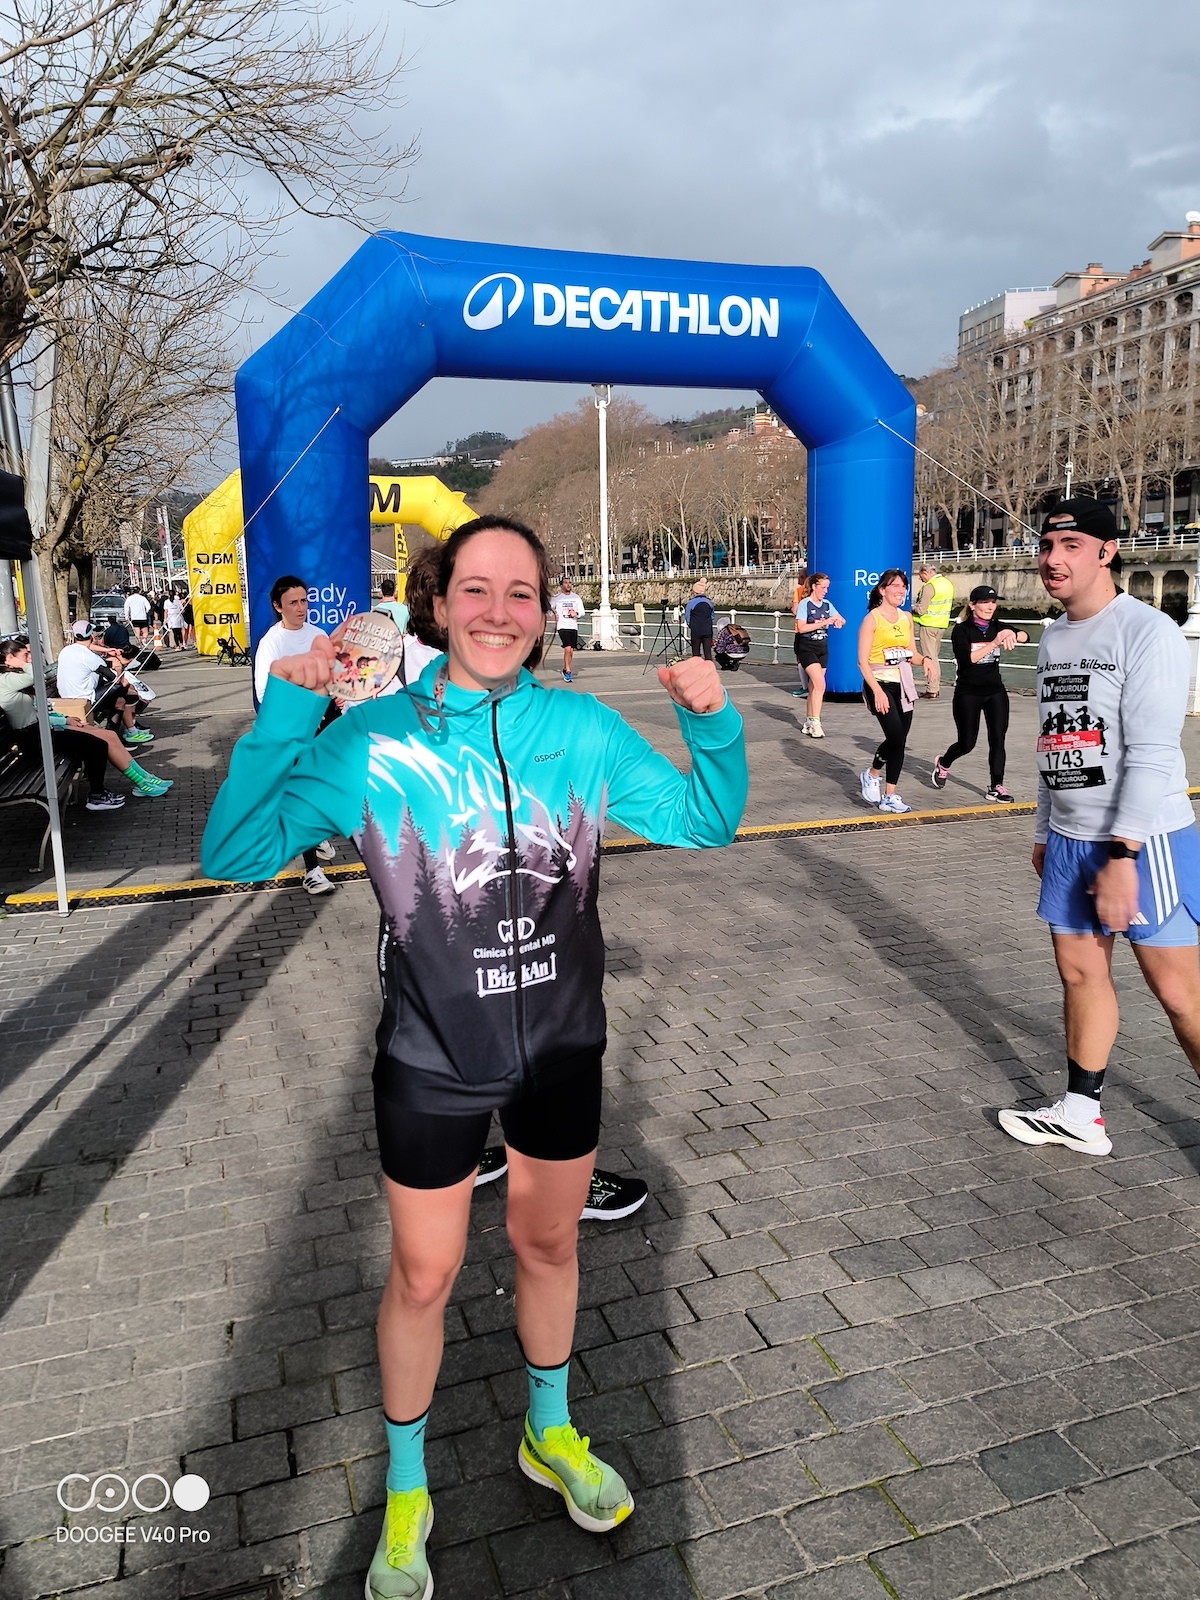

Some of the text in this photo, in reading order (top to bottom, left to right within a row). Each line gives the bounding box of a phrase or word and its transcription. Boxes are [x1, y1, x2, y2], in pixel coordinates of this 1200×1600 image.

[532, 282, 779, 338] DECATHLON
[369, 483, 400, 513] M
[212, 553, 233, 564] BM
[215, 583, 237, 595] BM
[307, 583, 347, 607] ady
[219, 613, 240, 625] BM
[350, 618, 394, 640] LAS ARENAS
[343, 630, 370, 647] BILBAO
[1044, 661, 1072, 672] Arenas
[1080, 658, 1117, 672] Bilbao
[534, 748, 566, 763] GSPORT
[1045, 749, 1084, 770] 1743
[541, 934, 556, 947] MD
